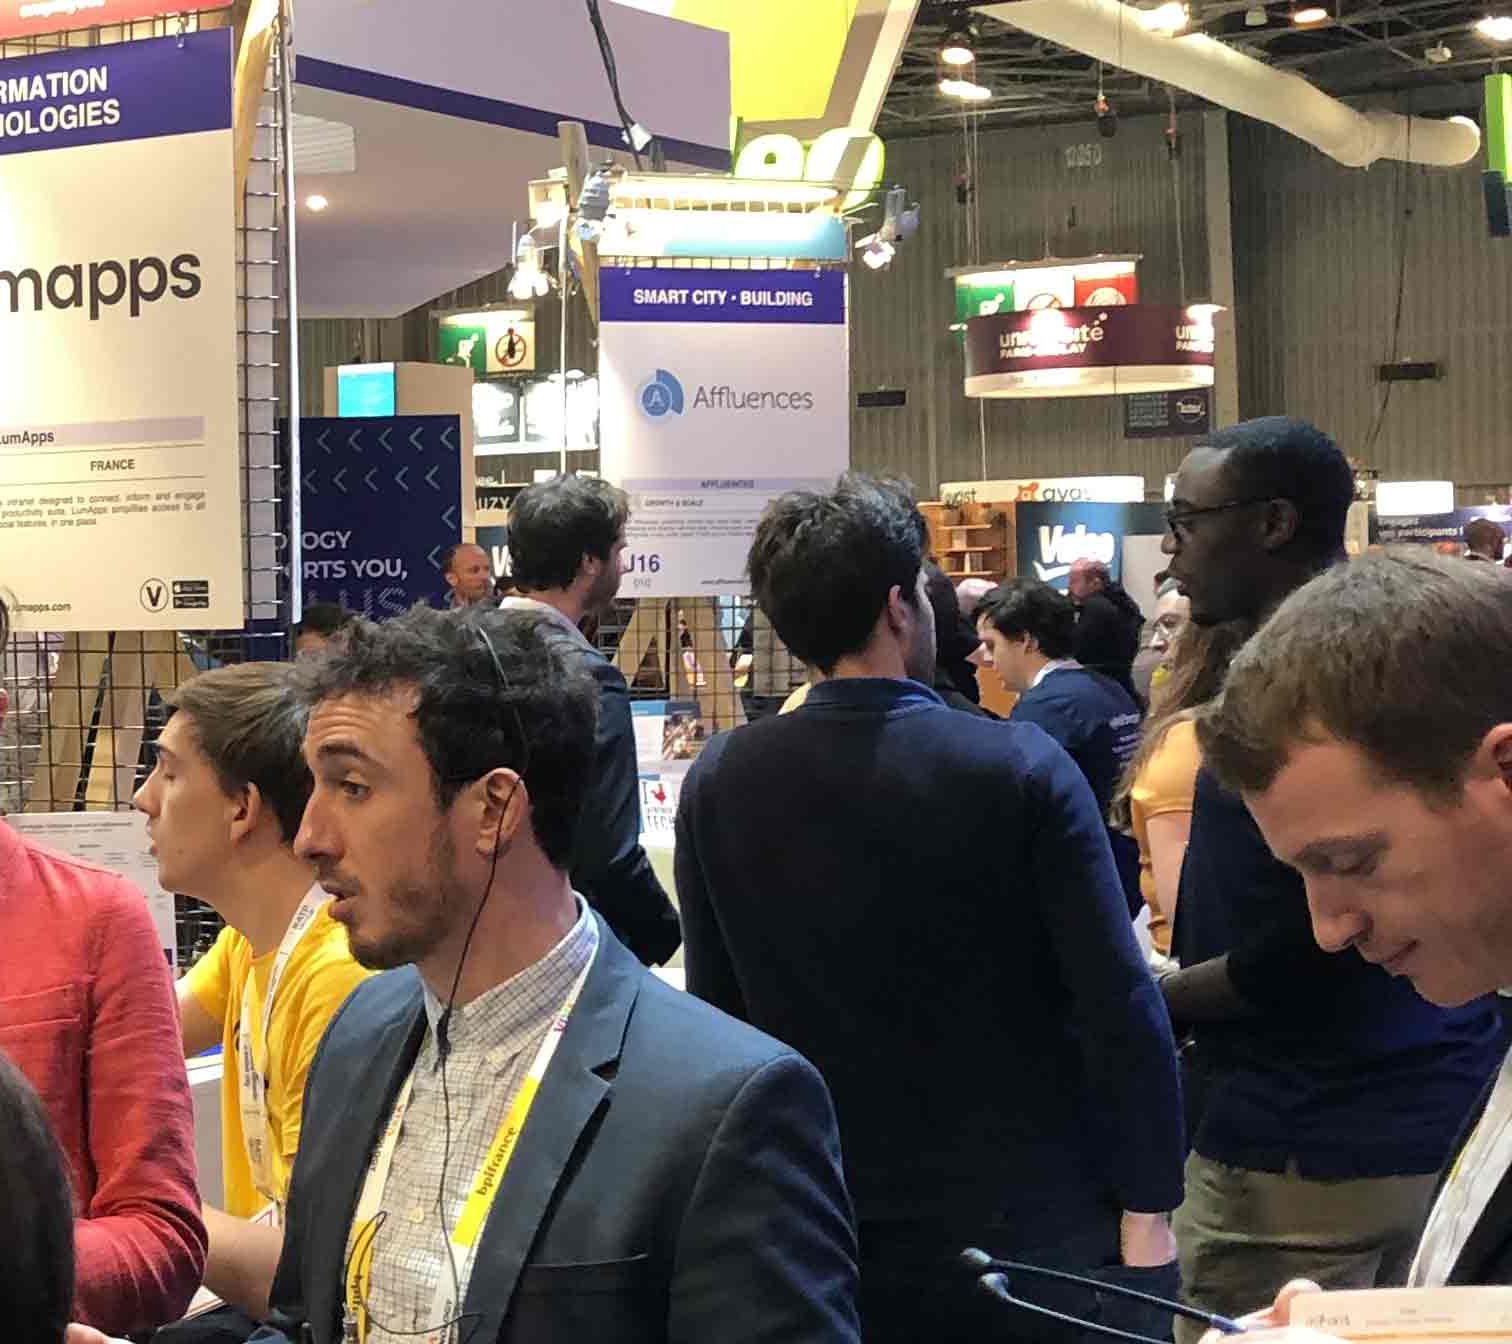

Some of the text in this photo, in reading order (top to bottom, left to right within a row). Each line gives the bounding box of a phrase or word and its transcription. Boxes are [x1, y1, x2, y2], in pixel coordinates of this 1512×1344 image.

[633, 289, 813, 307] SMART CITY BUILDING
[692, 384, 814, 410] Affluences
[90, 458, 136, 472] FRANCE
[351, 558, 408, 581] YOU,
[623, 553, 661, 574] J16
